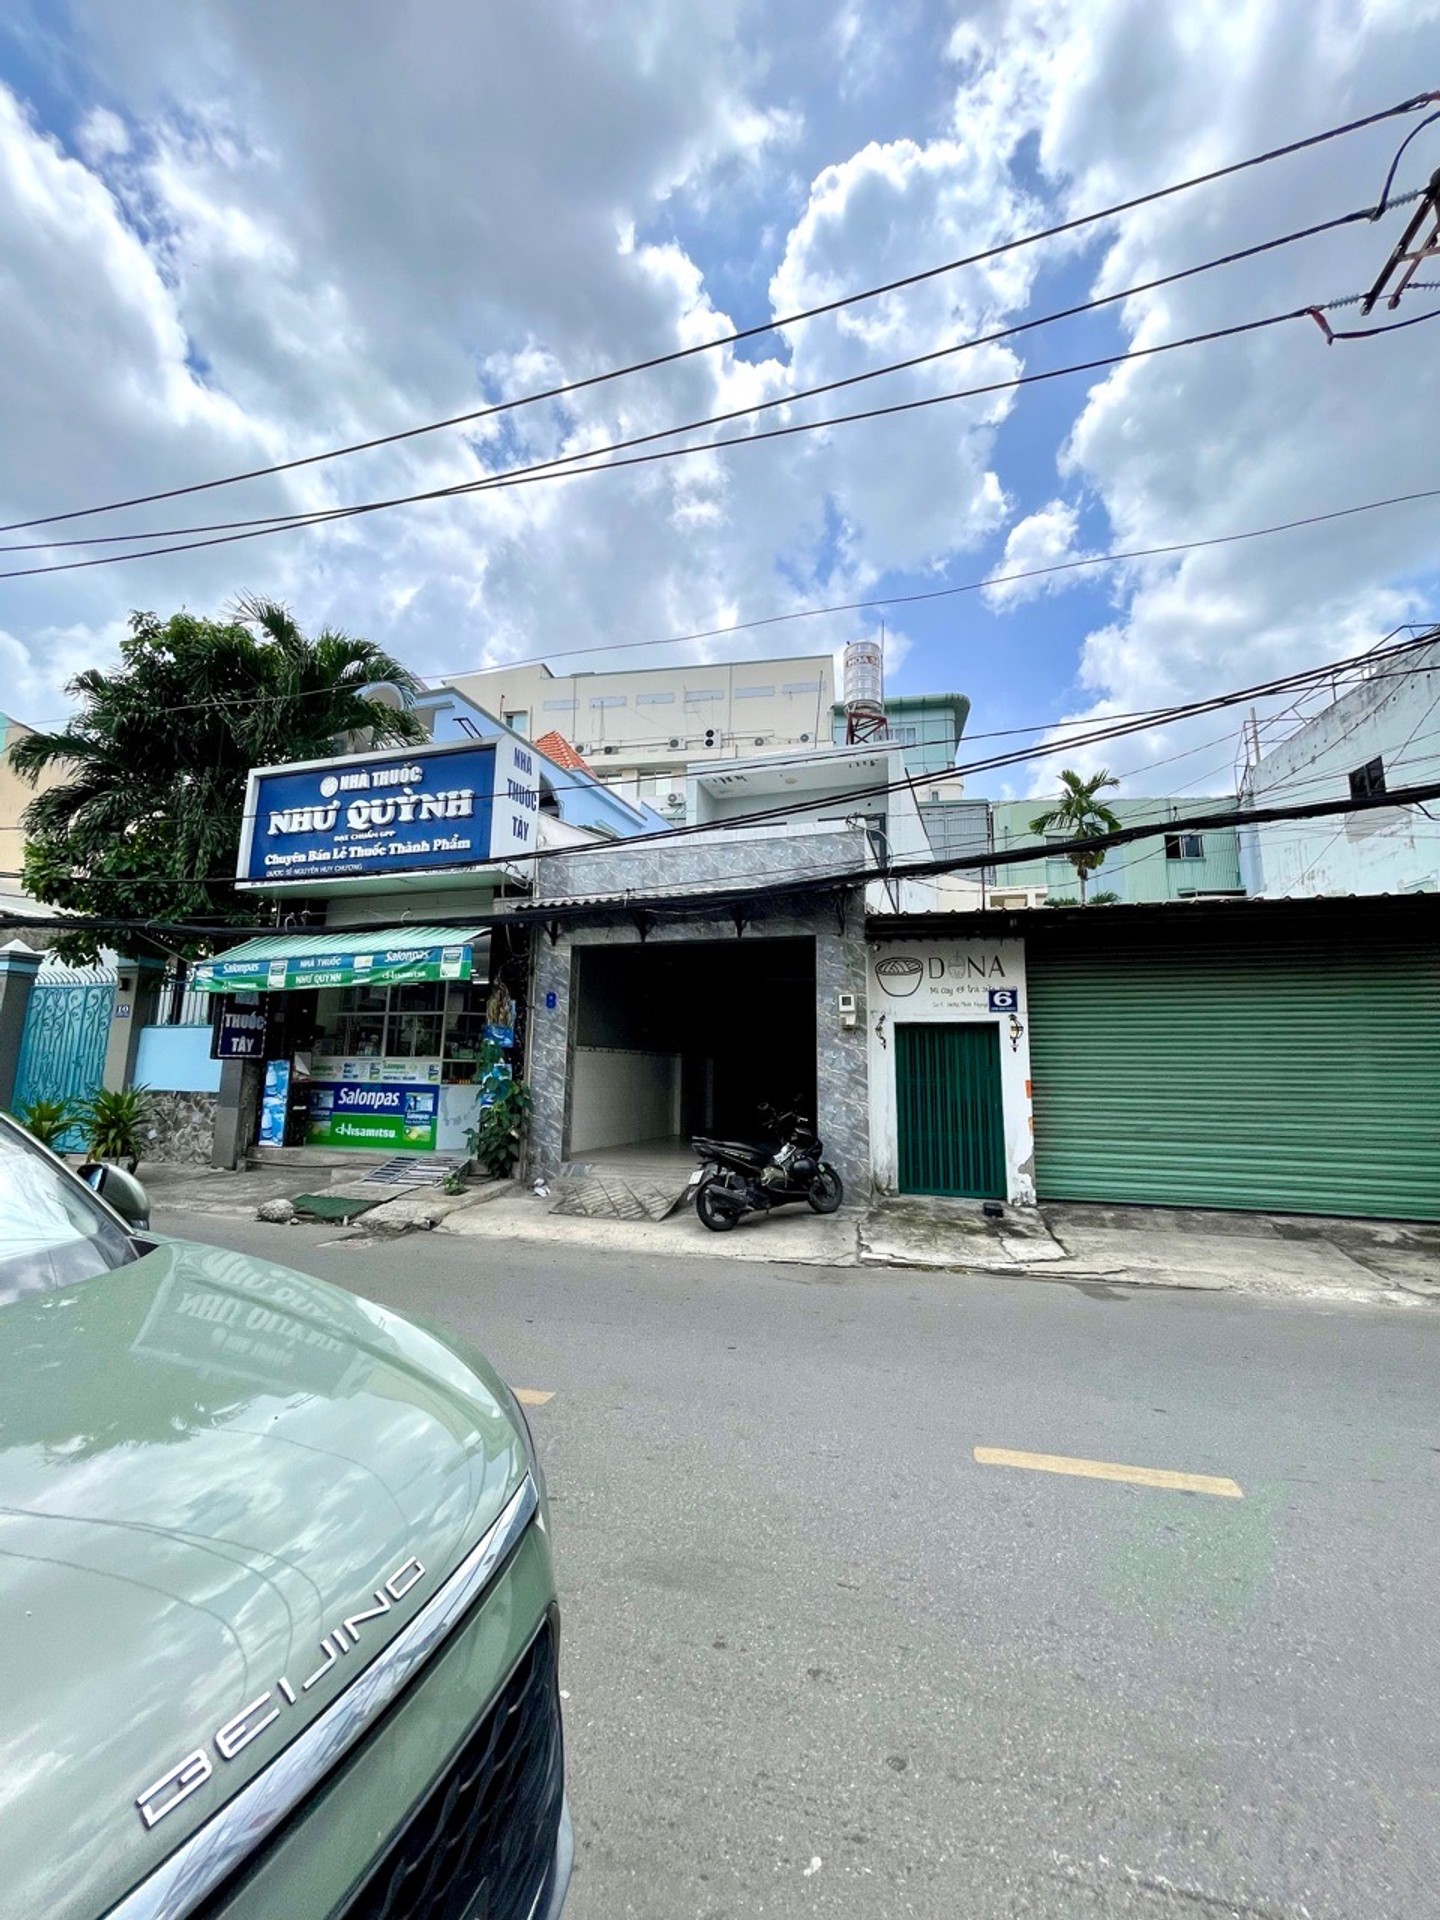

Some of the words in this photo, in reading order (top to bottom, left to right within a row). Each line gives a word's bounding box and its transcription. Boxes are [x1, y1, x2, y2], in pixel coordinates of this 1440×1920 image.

[514, 747, 532, 776] NHÀ
[339, 769, 370, 791] NHÀ
[372, 761, 423, 787] THUỐC
[506, 777, 537, 812] THUỐC
[267, 800, 341, 836] NHƯ
[346, 787, 475, 830] QUỲNH
[511, 814, 529, 842] TÂY
[264, 852, 307, 866] Chuyên
[308, 849, 331, 862] Bán
[348, 842, 387, 858] Thuốc
[388, 840, 430, 855] Thành
[432, 833, 471, 851] Phẩm
[222, 962, 259, 974] Salonpas
[993, 991, 1013, 1007] 6
[224, 1011, 266, 1031] THUỐC
[231, 1035, 256, 1053] TÂY
[338, 1087, 400, 1109] Salonpas
[335, 1122, 397, 1138] Hisamitsu
[136, 1555, 426, 1829] BEIJING
